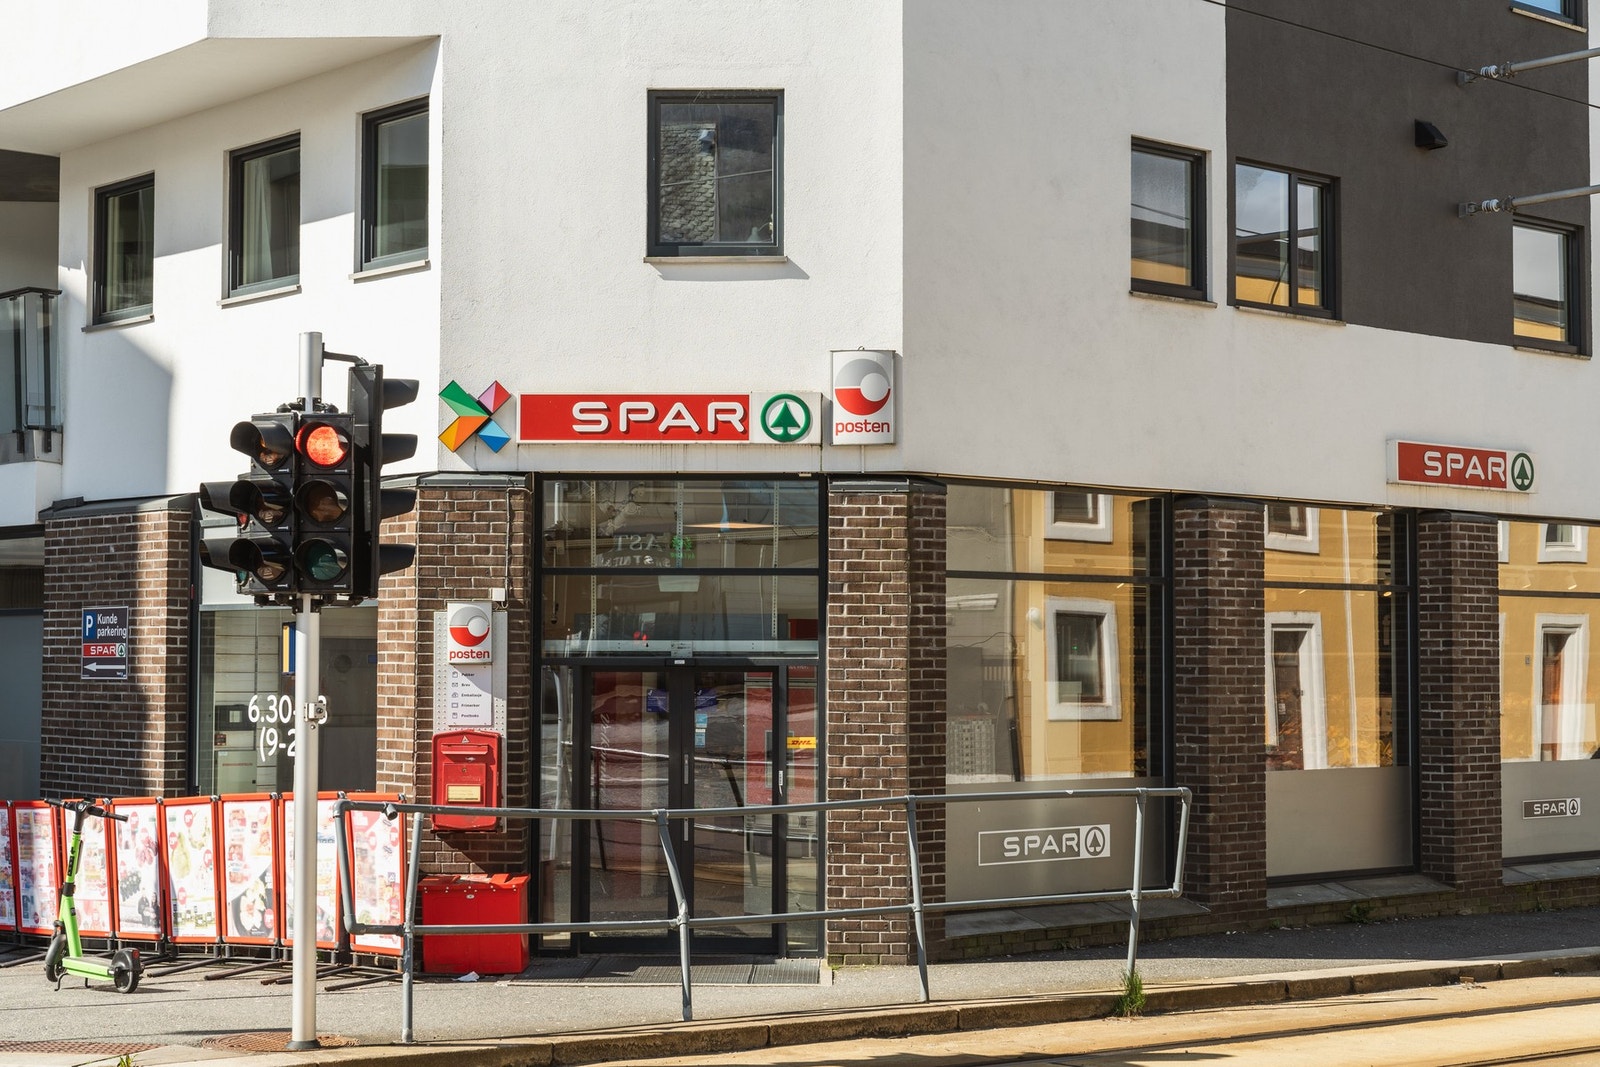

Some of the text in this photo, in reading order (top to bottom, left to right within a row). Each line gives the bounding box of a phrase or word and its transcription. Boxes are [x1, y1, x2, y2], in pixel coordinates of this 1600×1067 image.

[572, 401, 747, 433] SPAR
[835, 419, 890, 436] posten
[1423, 450, 1506, 482] SPAR
[85, 615, 94, 637] P
[97, 613, 118, 625] Kunde
[96, 625, 128, 639] parkering
[90, 645, 116, 655] SPAR
[449, 649, 490, 661] posten
[248, 694, 328, 725] 6.303
[260, 726, 296, 763] (9-2
[1533, 802, 1566, 815] SPAR
[1003, 833, 1079, 857] SPAR
